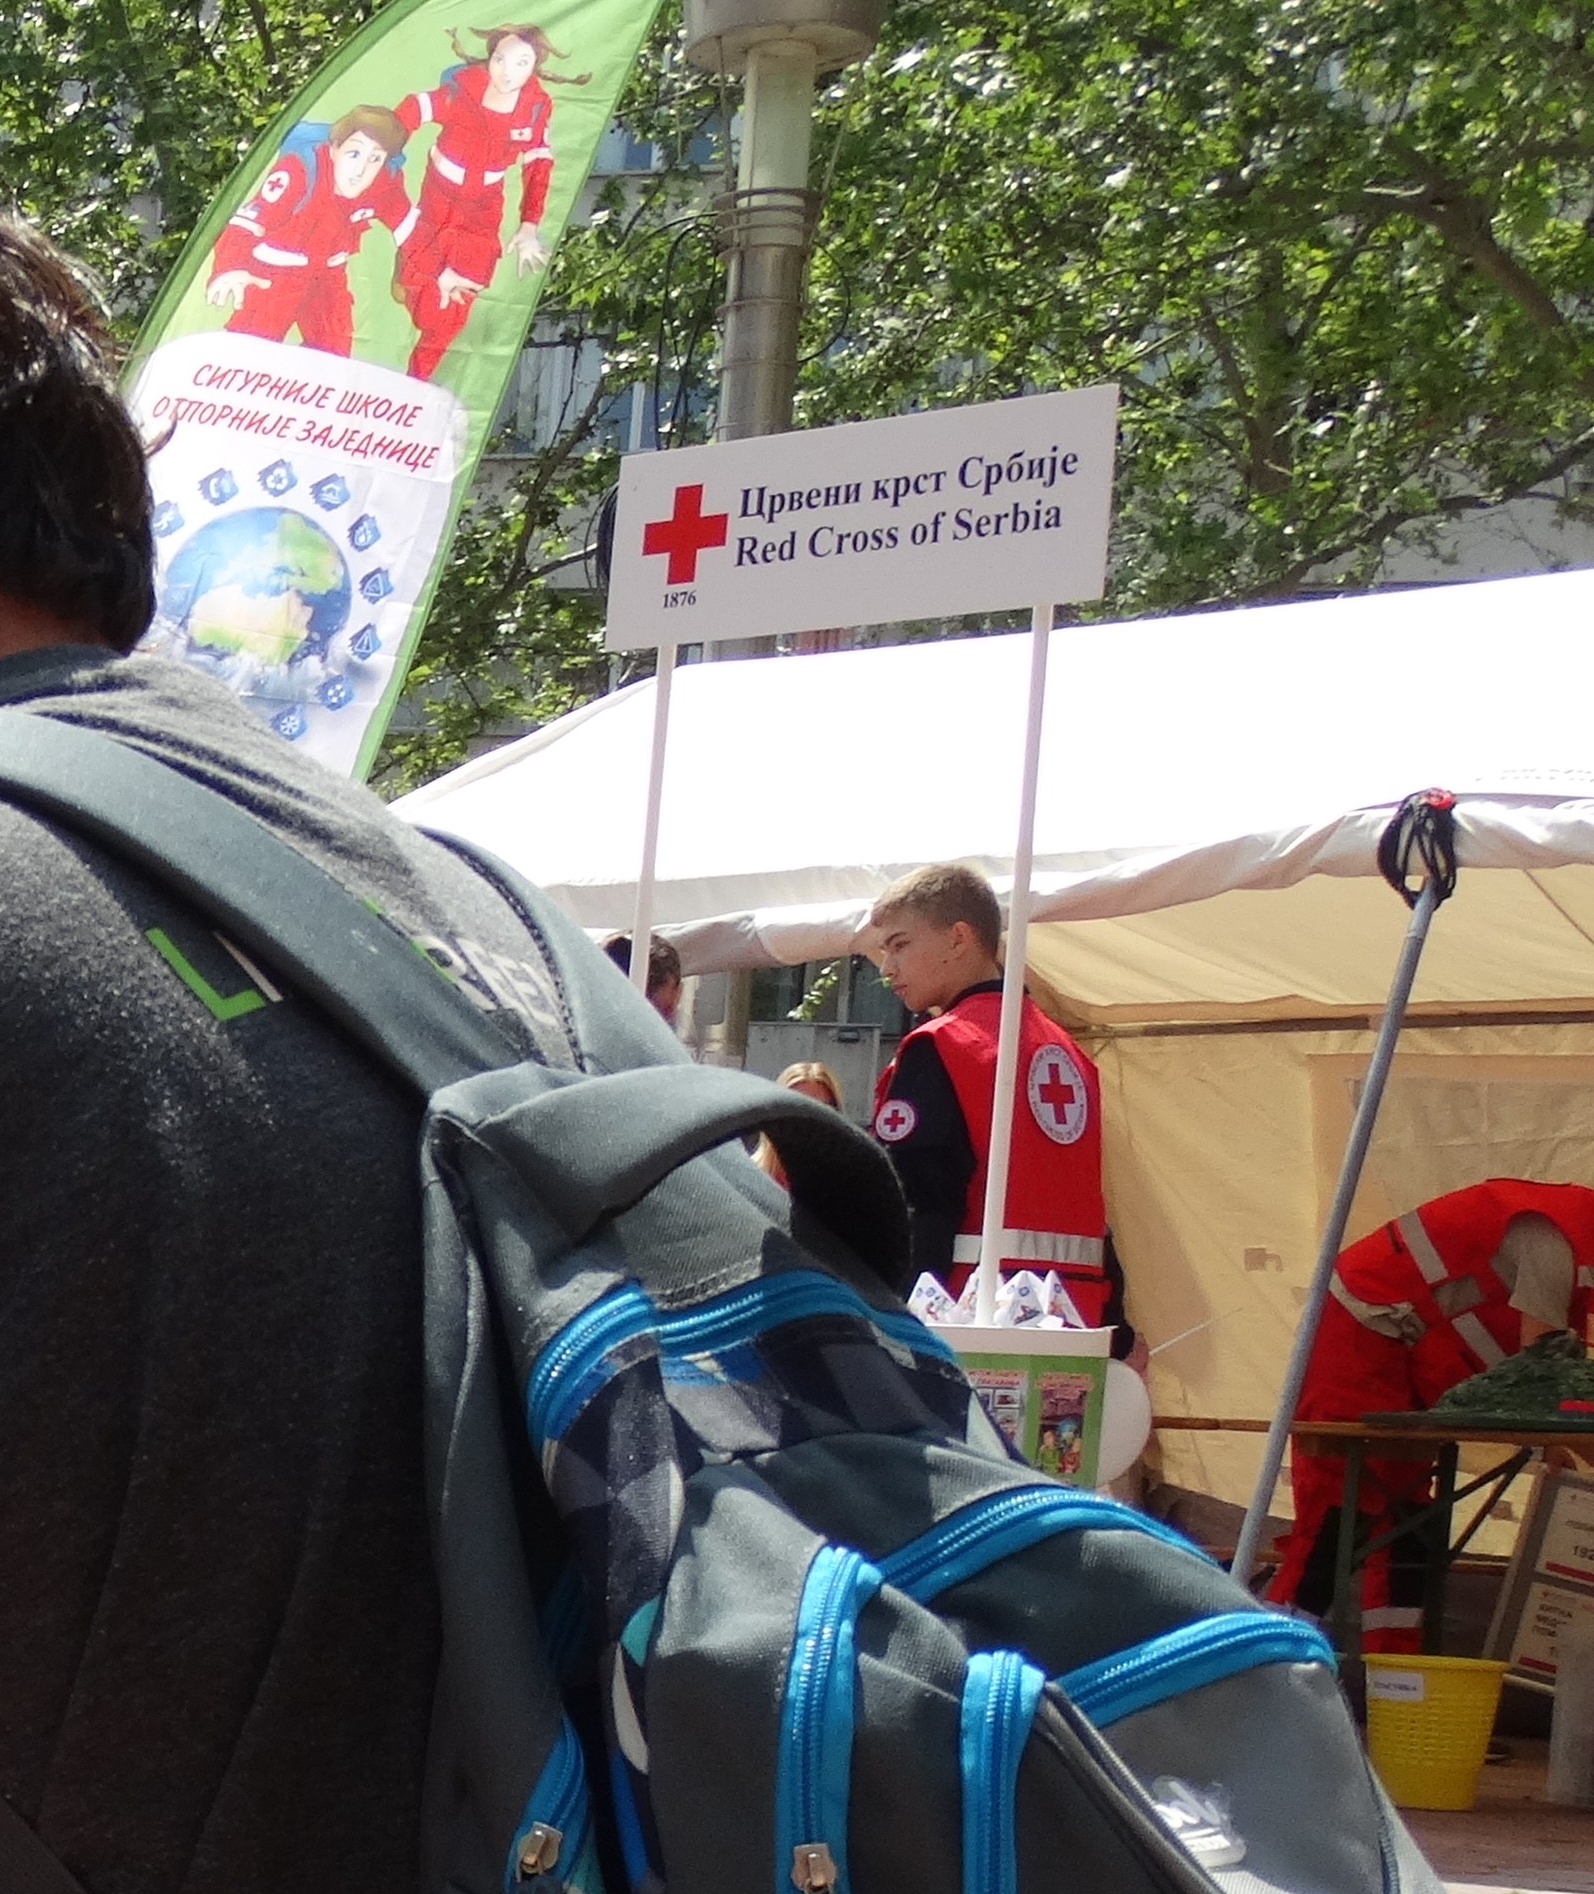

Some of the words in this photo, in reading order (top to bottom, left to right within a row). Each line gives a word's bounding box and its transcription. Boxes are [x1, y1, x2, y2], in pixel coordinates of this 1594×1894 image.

[192, 364, 336, 408] СИГУРНИЈЕ
[335, 390, 423, 428] ШКОЛЕ
[152, 396, 297, 438] ОТПОРНИЈЕ
[295, 420, 441, 473] ЗАЈЕДНИЦЕ
[739, 480, 861, 523] Црвени
[872, 470, 947, 506] крст
[957, 446, 1079, 492] Србије
[734, 533, 796, 567] Red
[808, 519, 898, 559] Cross
[911, 511, 942, 546] of
[953, 500, 1063, 543] Serbia
[661, 589, 697, 609] 1876
